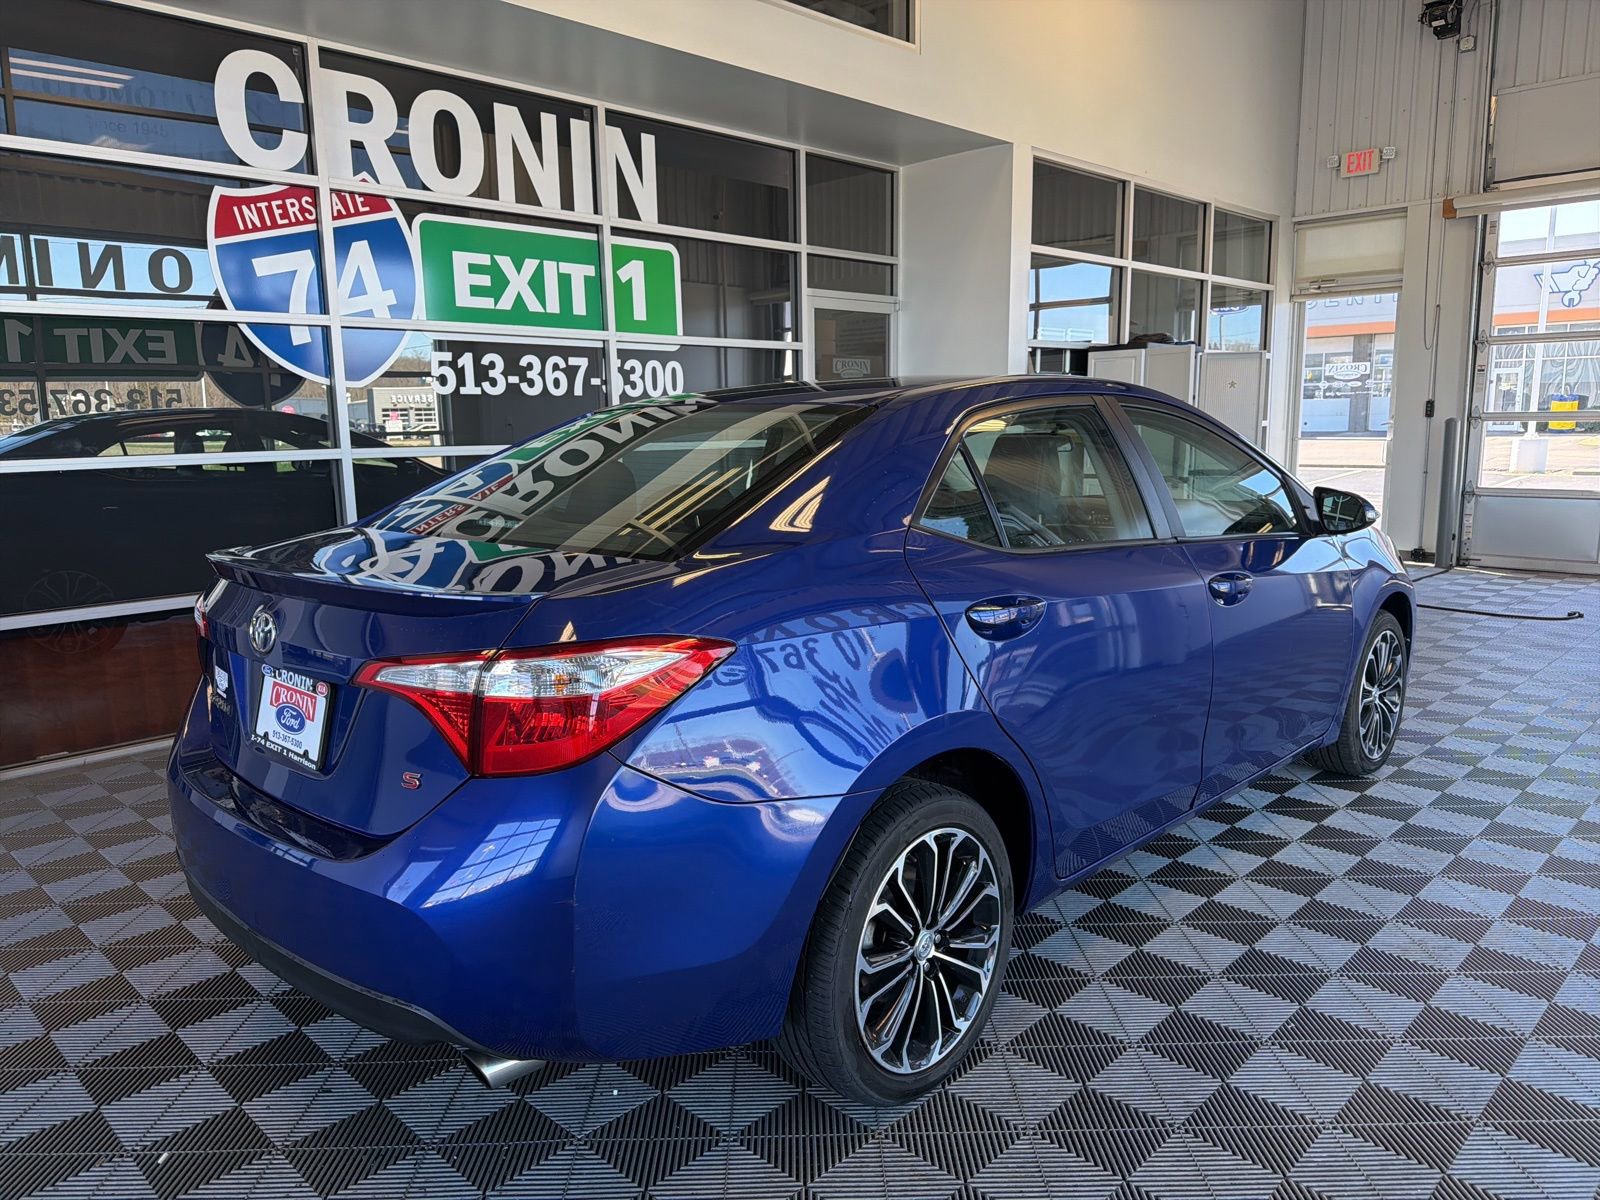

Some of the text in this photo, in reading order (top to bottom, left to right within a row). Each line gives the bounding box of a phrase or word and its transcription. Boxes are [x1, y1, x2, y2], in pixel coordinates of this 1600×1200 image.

[214, 49, 658, 225] CRONIN
[1346, 149, 1373, 174] EXIT
[233, 192, 369, 231] INTERSATE
[251, 239, 397, 346] 74
[452, 250, 647, 321] EXIT 1
[834, 359, 869, 374] CRONIN
[275, 669, 314, 691] CRONIN
[272, 686, 315, 722] CRONIN
[281, 708, 301, 730] Ford
[272, 729, 304, 750] 513-367-5300
[266, 740, 282, 753] EXIT
[288, 751, 316, 771] Harrison
[400, 771, 421, 789] S
